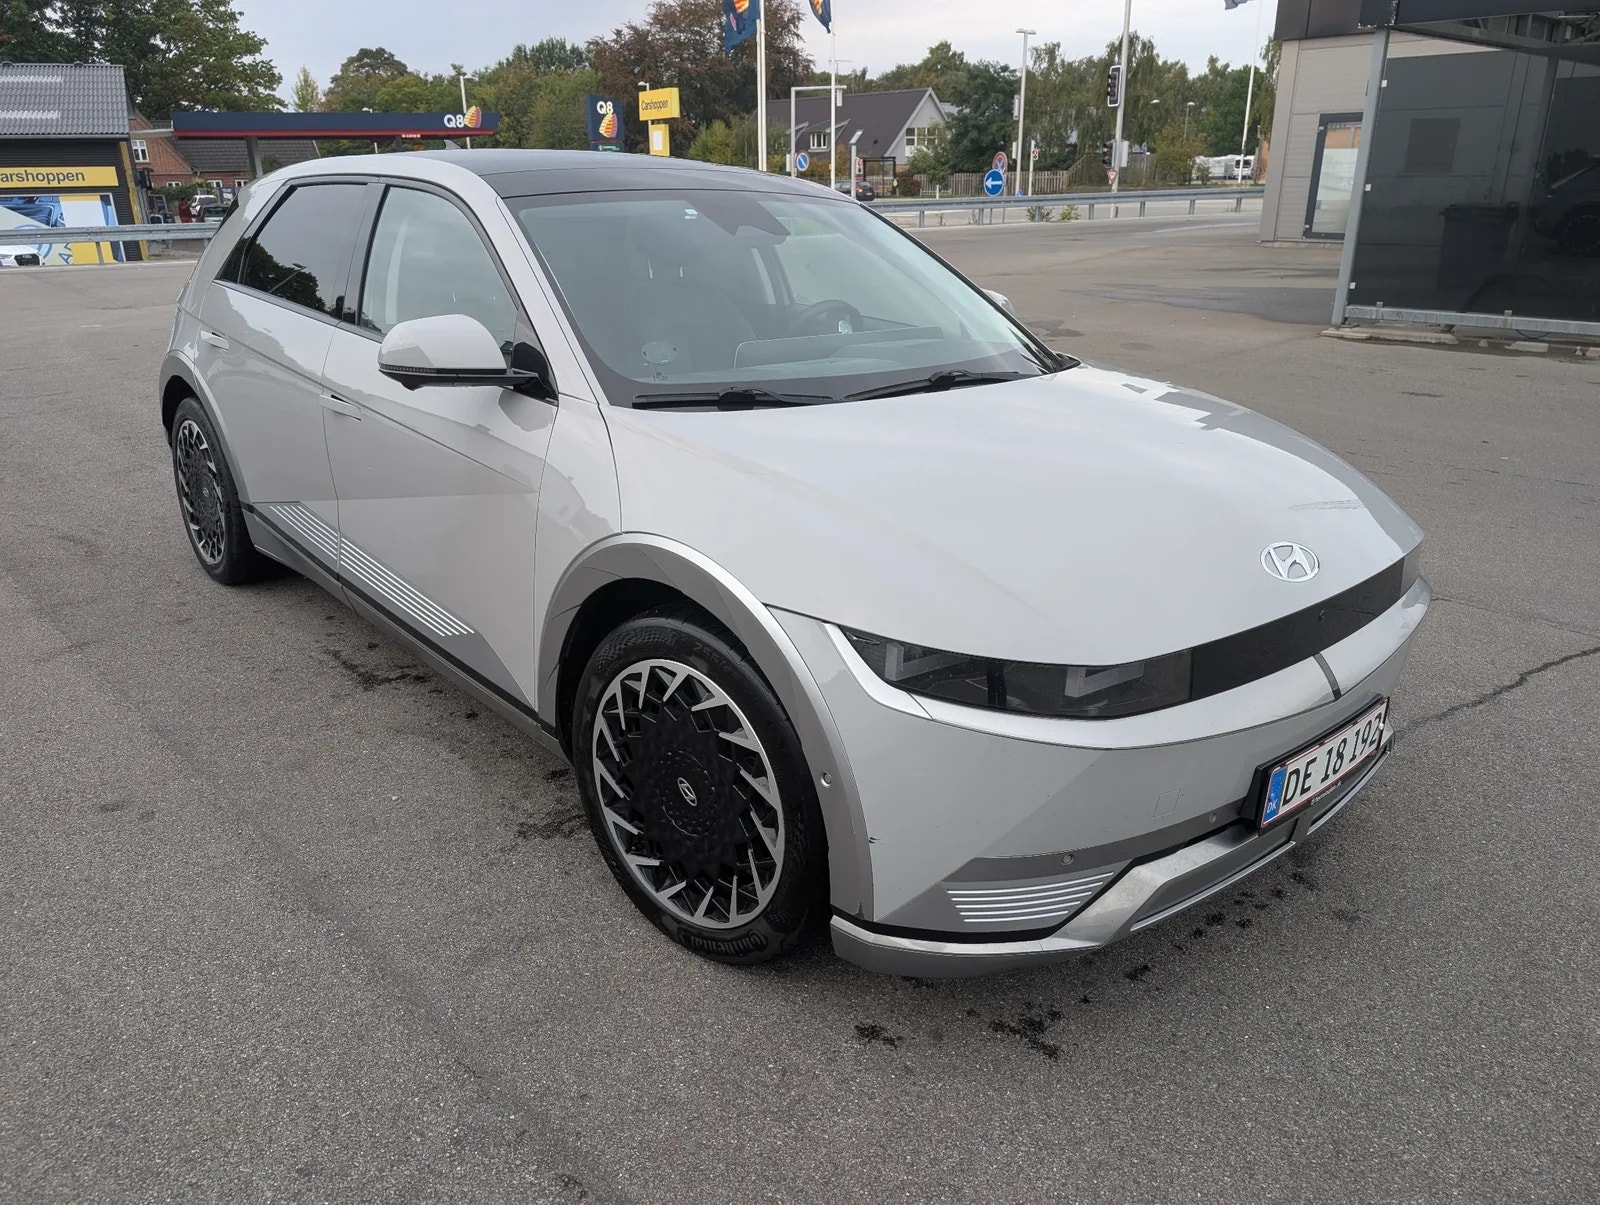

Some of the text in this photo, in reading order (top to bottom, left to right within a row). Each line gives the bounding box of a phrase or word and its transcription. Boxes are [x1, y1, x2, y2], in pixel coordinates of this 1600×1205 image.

[597, 101, 613, 114] Q8
[443, 114, 465, 128] Q8
[0, 169, 85, 185] arshoppen
[1282, 756, 1318, 807] DE
[1320, 737, 1348, 784] 18
[1349, 712, 1382, 763] 192
[1267, 798, 1278, 814] DK
